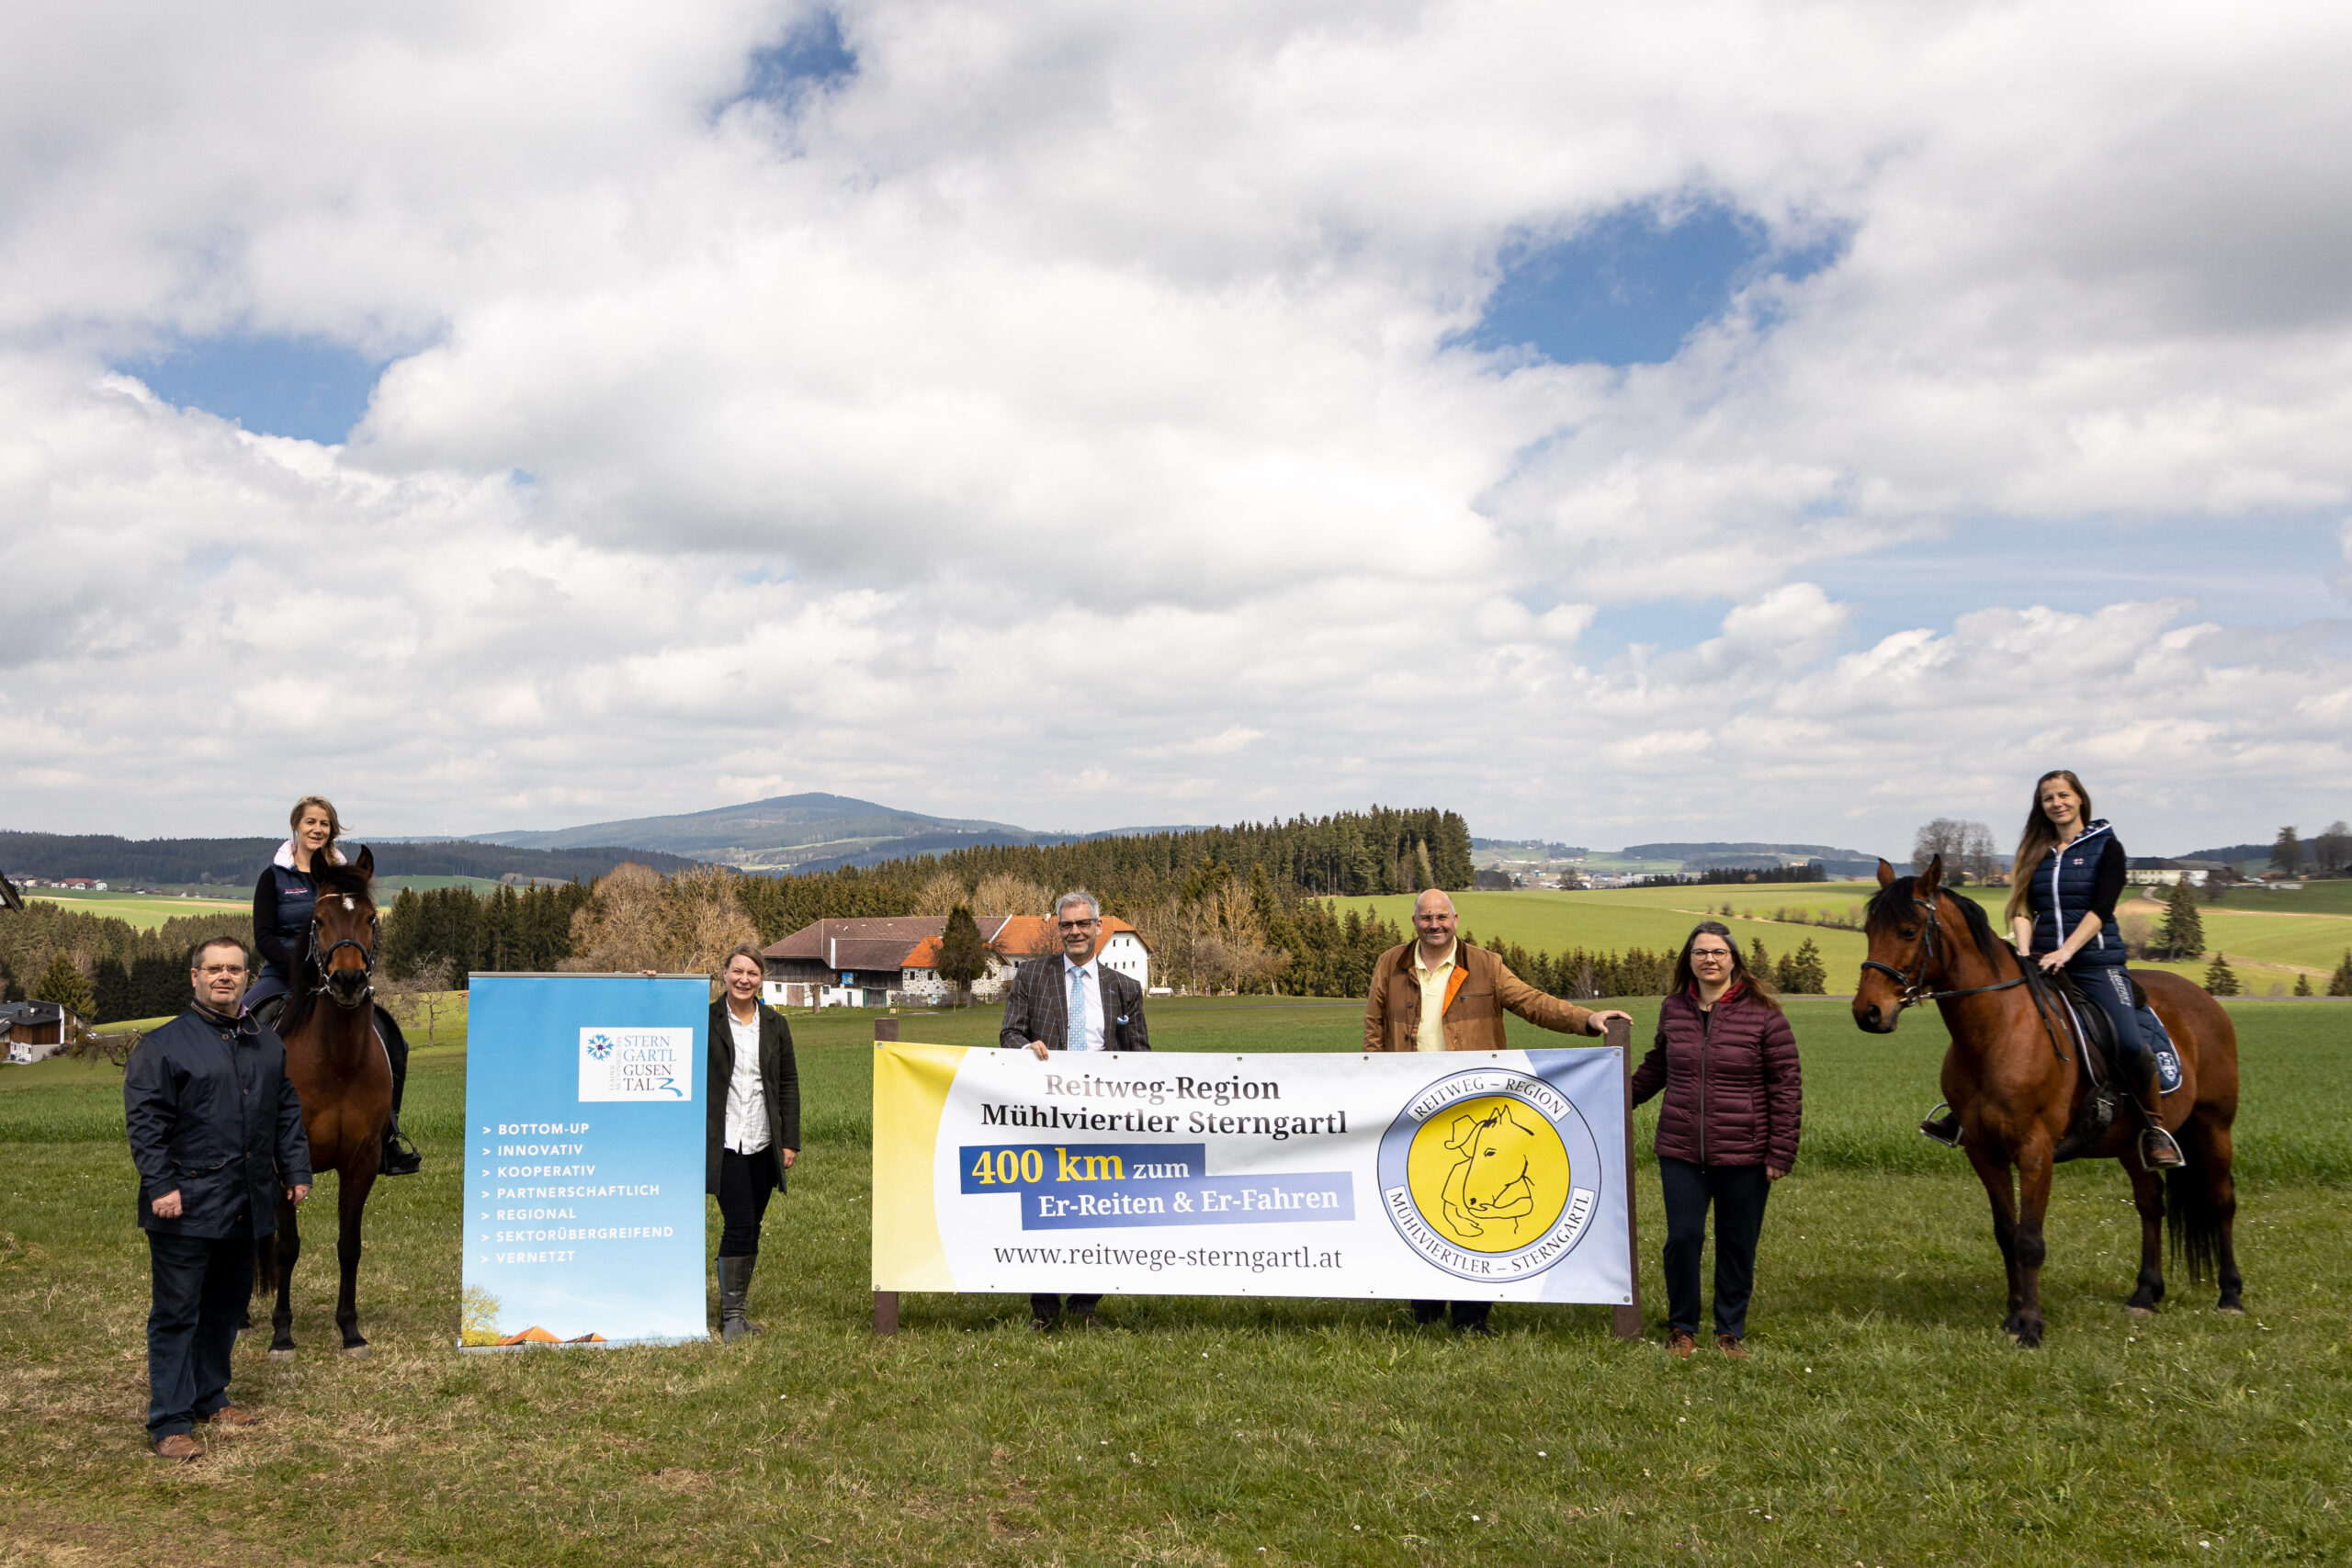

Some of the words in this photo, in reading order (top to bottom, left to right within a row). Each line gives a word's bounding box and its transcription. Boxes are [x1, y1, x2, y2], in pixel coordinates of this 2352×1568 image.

[624, 1035, 671, 1047] STERN
[623, 1049, 677, 1062] GARTL
[623, 1064, 672, 1077] GUSEN
[623, 1077, 655, 1091] TAL
[1044, 1073, 1282, 1106] Reitweg-Region
[1414, 1077, 1484, 1118] REITWEG
[1506, 1077, 1565, 1116] REGION
[498, 1122, 590, 1135] BOTTOM-UP
[980, 1103, 1180, 1134] Mühlviertler
[1189, 1110, 1348, 1140] Sterngartl
[497, 1145, 583, 1156] INNOVATIV
[497, 1165, 596, 1178] KOOPERATIV
[971, 1149, 1044, 1185] 400
[1055, 1147, 1125, 1182] km
[1133, 1160, 1190, 1179] zum
[497, 1184, 660, 1199] PARTNERSCHAFTLICH
[1038, 1192, 1165, 1218] Er-Reiten
[1174, 1191, 1194, 1213] &
[1201, 1187, 1340, 1213] Er-Fahren
[496, 1208, 577, 1221] REGIONAL
[496, 1226, 673, 1243] SEKTORÜBERGREIFEND
[1390, 1192, 1491, 1274] MÜHLVIERTLER
[1511, 1196, 1589, 1272] STERNGARTL
[496, 1250, 575, 1264] VERNETZT
[994, 1244, 1342, 1273] www.reitwege-sterngartl.at
